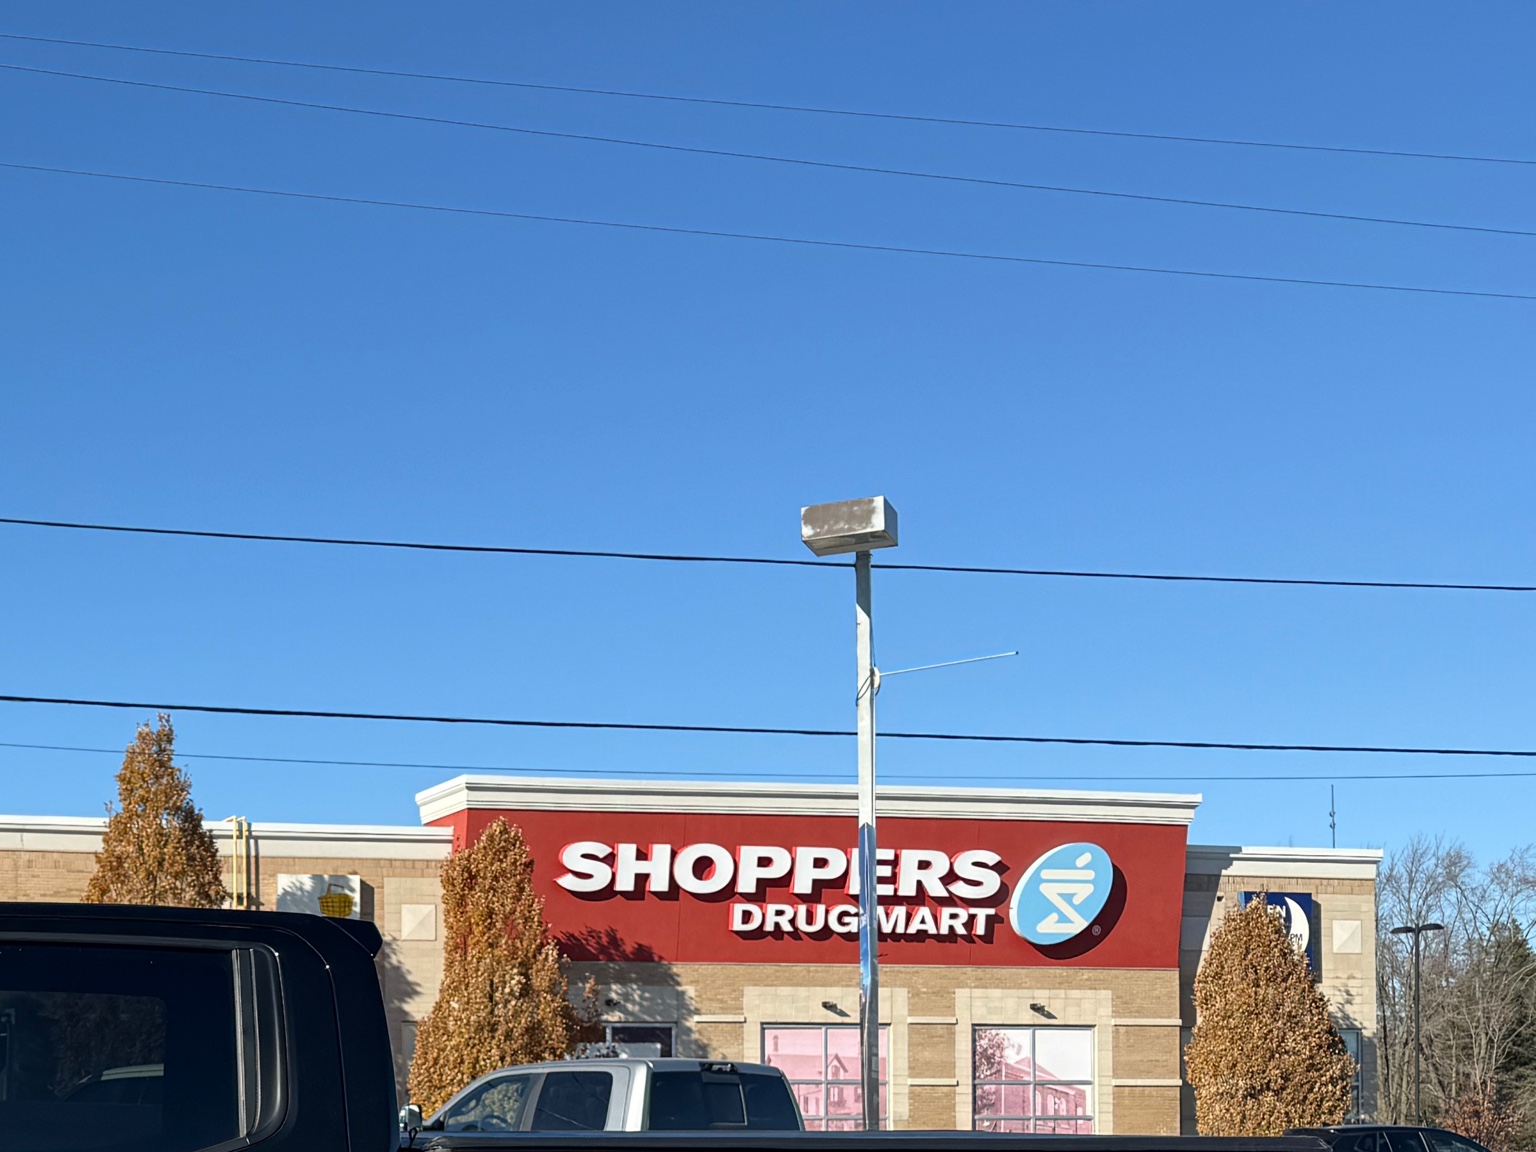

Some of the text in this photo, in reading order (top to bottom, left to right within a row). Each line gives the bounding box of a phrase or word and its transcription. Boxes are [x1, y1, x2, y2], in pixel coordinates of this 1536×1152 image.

[553, 841, 1002, 898] SHOPPERS
[729, 903, 995, 936] DRUG MART
